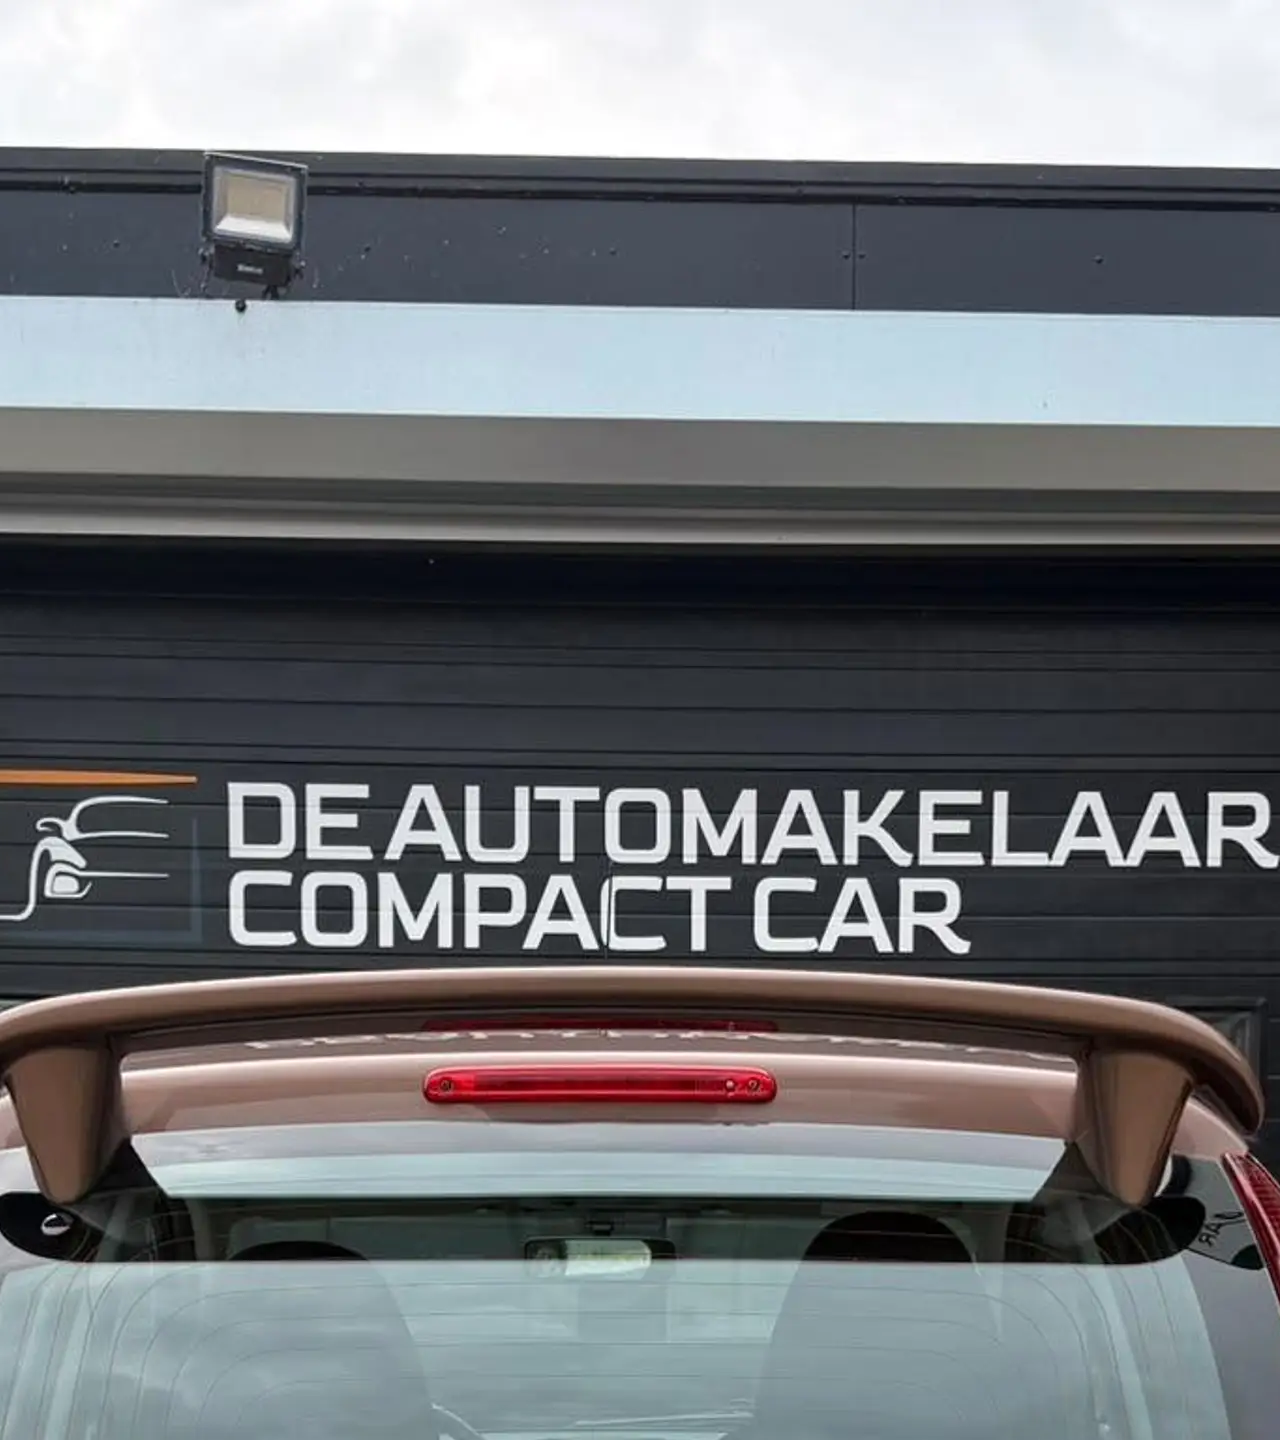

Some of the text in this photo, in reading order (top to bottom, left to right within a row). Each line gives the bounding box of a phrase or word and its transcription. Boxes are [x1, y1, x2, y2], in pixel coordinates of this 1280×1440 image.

[227, 781, 1280, 869] DE AUTOMAKELAAR
[228, 869, 972, 955] COMPACT CAR
